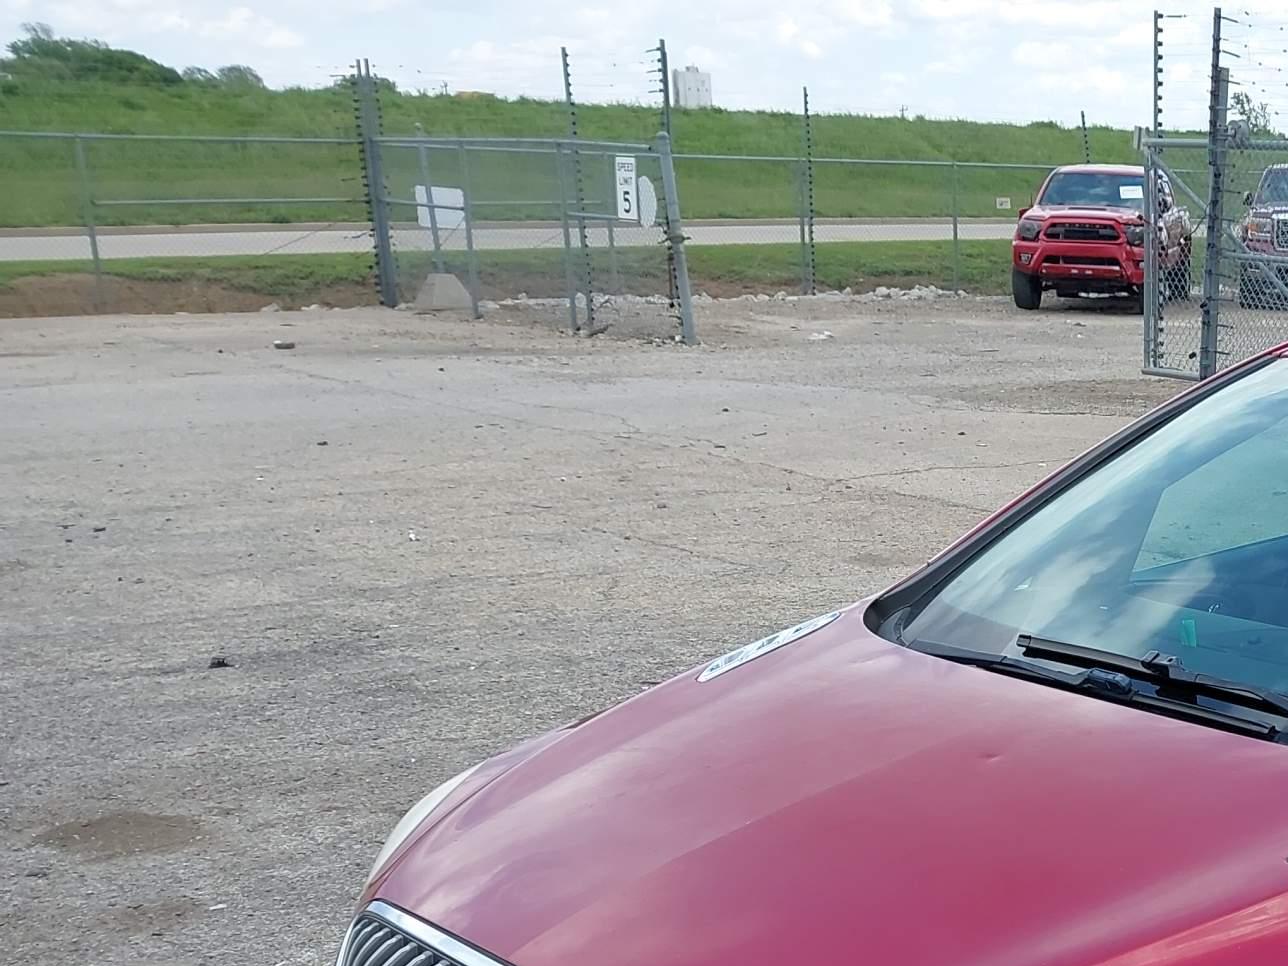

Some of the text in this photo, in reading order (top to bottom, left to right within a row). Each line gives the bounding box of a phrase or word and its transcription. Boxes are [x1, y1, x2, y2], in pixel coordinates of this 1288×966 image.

[617, 162, 633, 172] SPEED
[618, 176, 633, 186] LIMIT
[623, 190, 631, 213] 5
